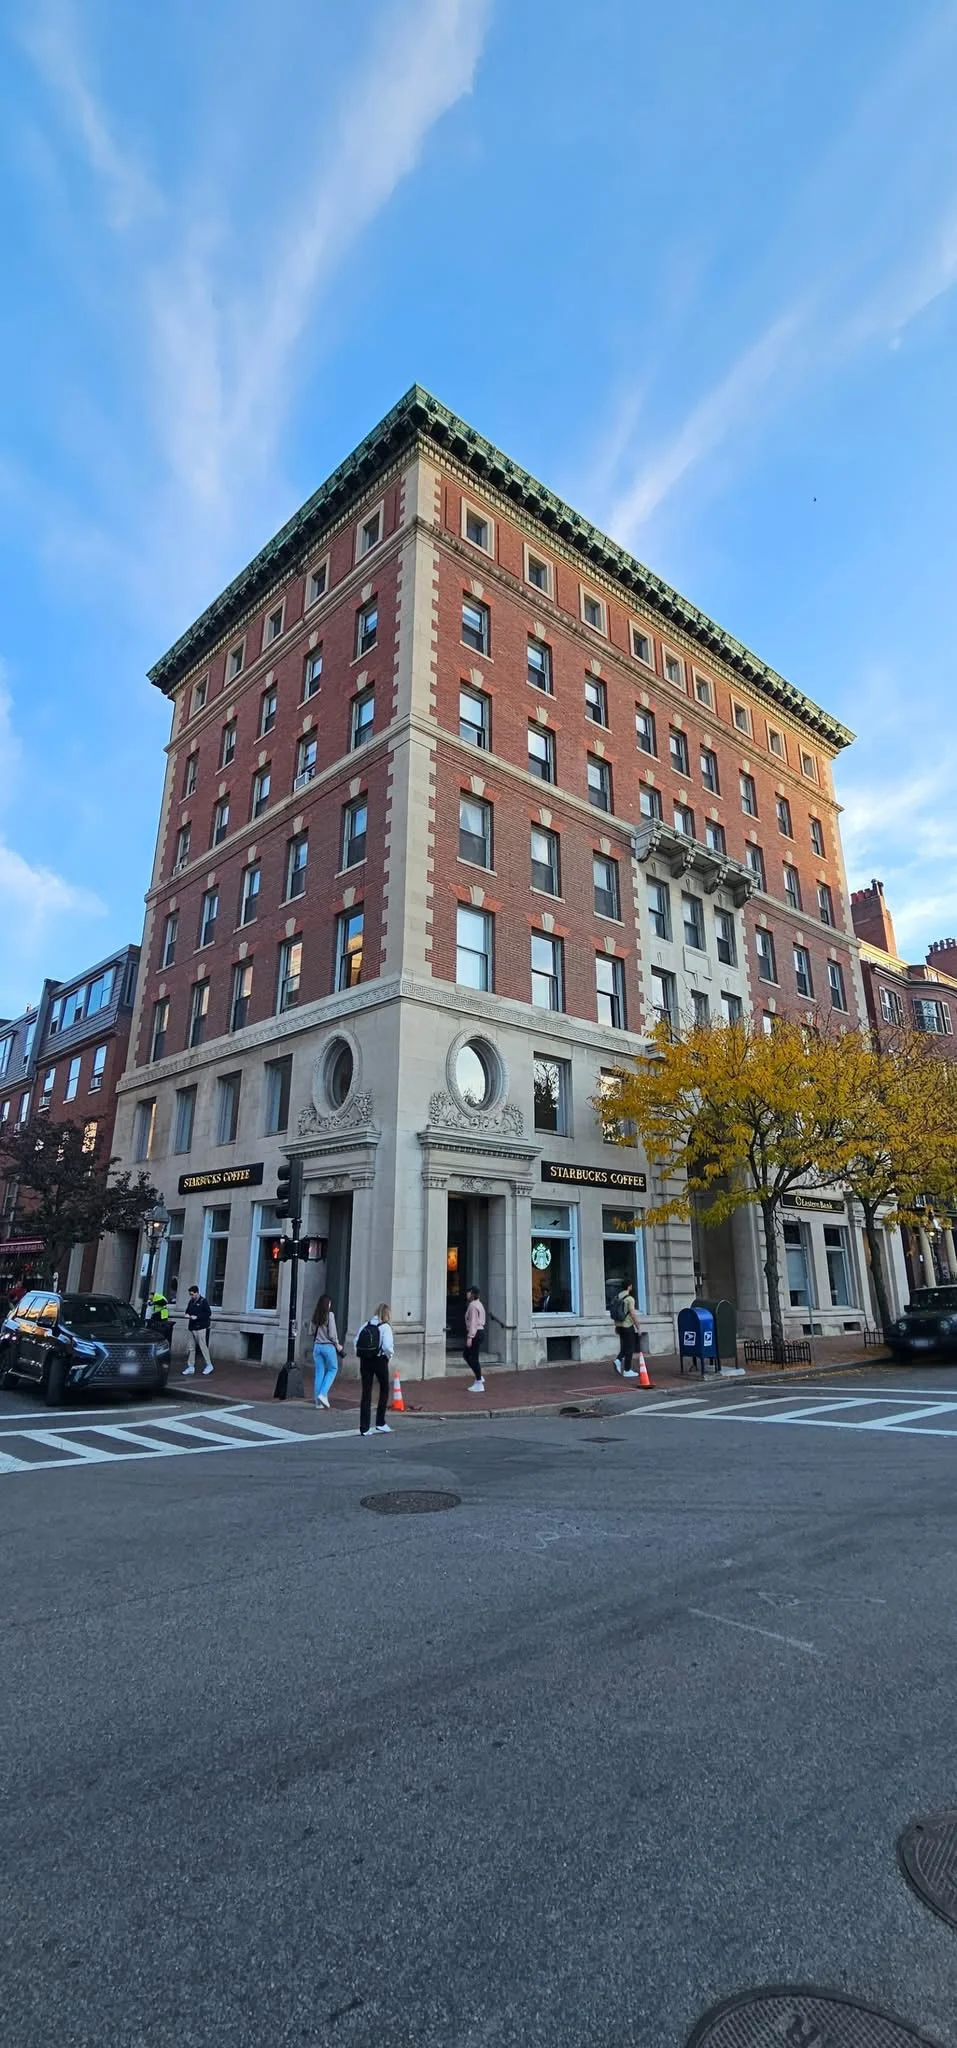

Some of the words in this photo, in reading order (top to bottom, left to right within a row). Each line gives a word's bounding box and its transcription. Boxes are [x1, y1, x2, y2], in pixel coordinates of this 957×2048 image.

[183, 1174, 221, 1187] STARBUCKS
[223, 1169, 251, 1182] COFFEE
[550, 1166, 608, 1183] STARBUCKS
[610, 1173, 645, 1186] COFFEE
[820, 1200, 833, 1209] Bank
